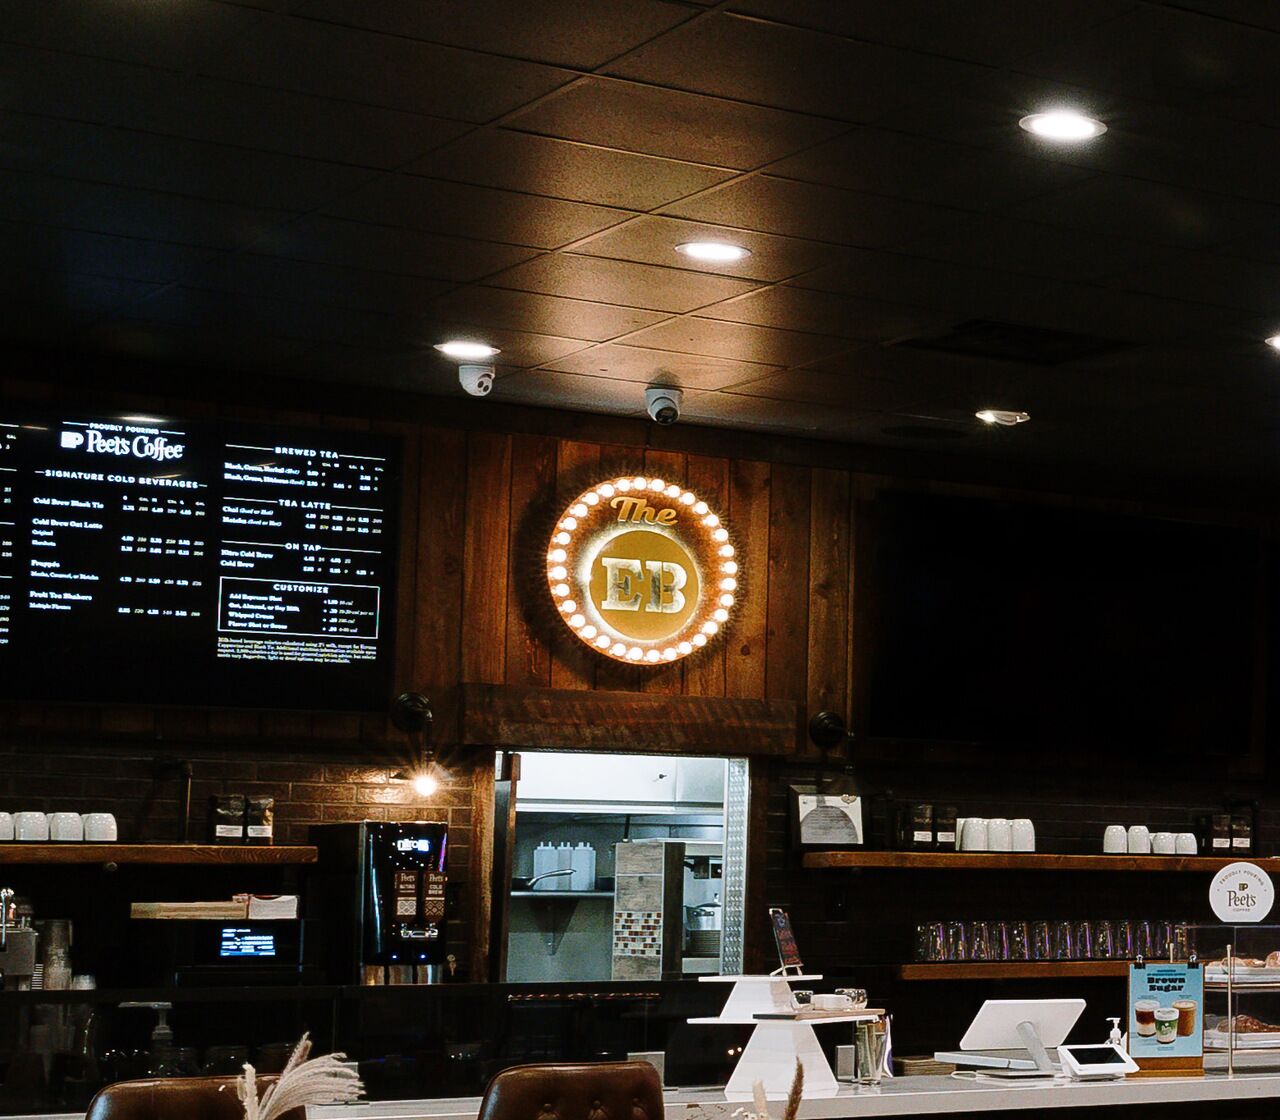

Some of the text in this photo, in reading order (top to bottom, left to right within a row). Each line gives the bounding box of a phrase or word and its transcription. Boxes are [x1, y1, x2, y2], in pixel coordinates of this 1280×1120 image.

[132, 436, 184, 461] Coffee
[275, 447, 339, 459] BREWED TEA
[45, 469, 199, 489] SIGNATURE COLD BEVERAGES
[279, 499, 331, 510] TEA LATTE
[610, 496, 679, 526] The
[285, 542, 322, 551] ON TAP
[273, 584, 329, 594] CUSTOMIZE
[601, 557, 688, 614] EB
[1148, 984, 1184, 992] Sugar
